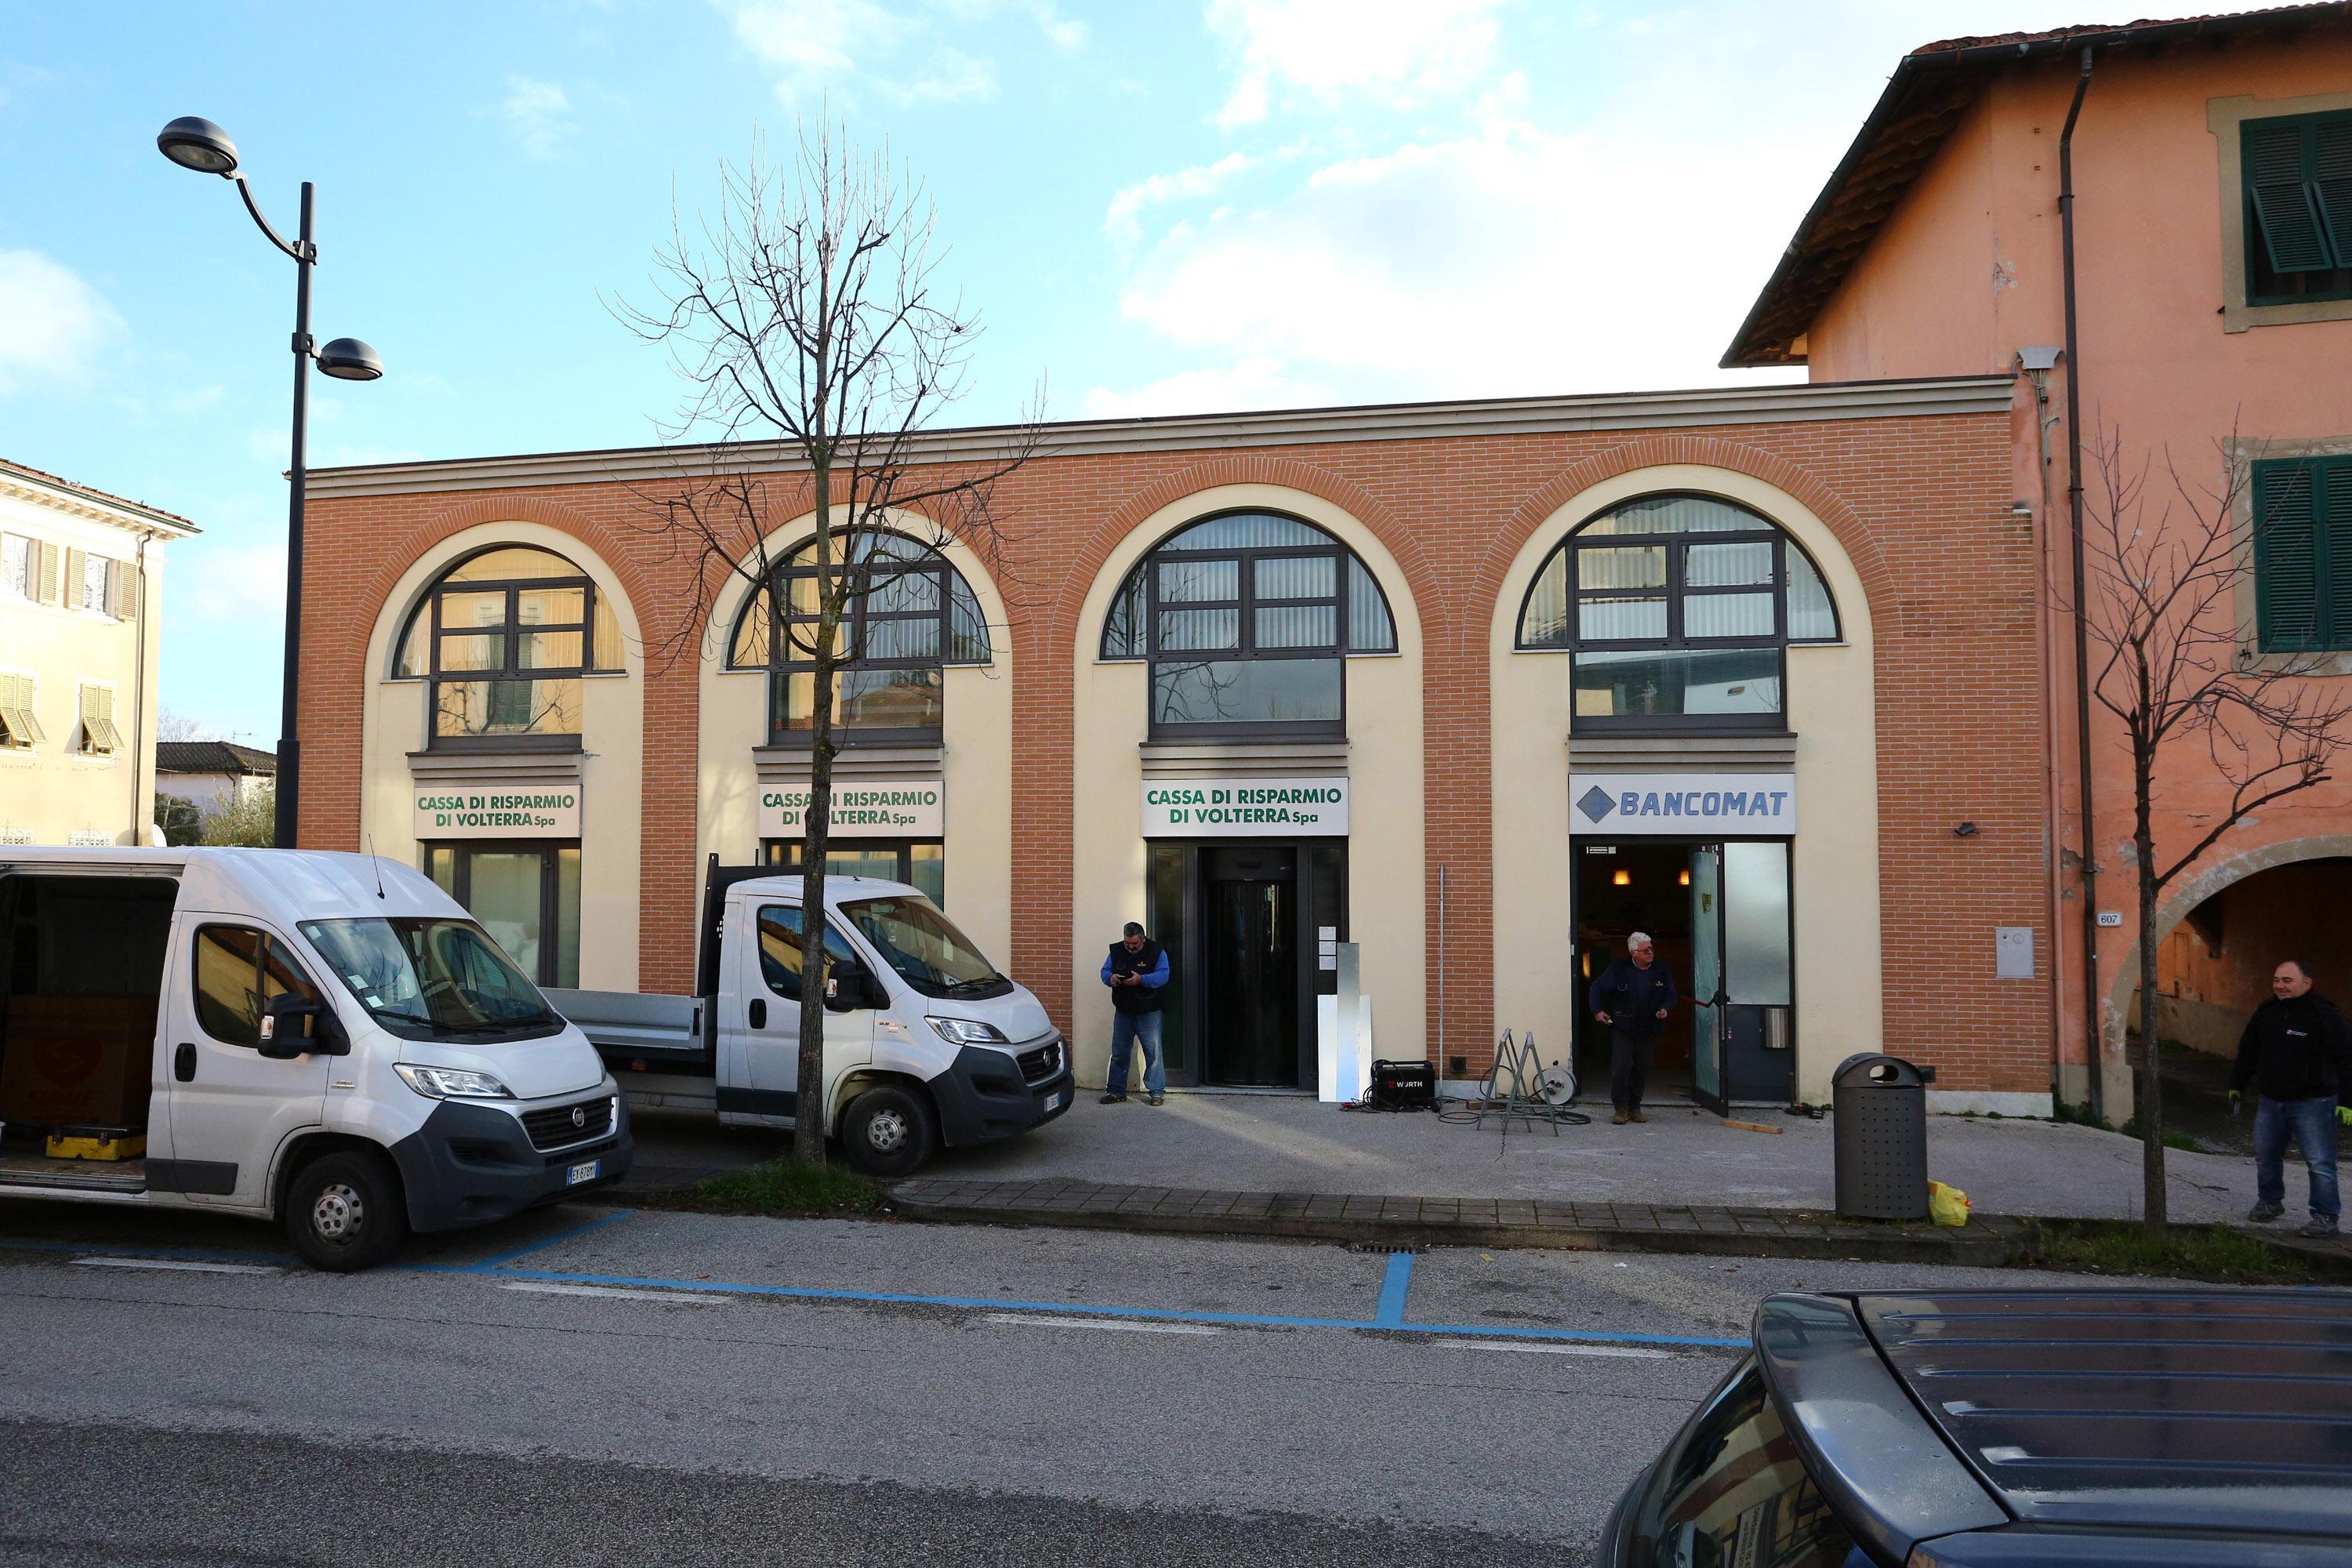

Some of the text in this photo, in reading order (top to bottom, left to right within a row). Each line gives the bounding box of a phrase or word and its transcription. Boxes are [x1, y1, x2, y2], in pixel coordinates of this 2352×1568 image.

[418, 794, 575, 810] CASSA DI RISPARMIO
[763, 793, 812, 808] CASSA
[843, 791, 937, 806] RISPARMIO
[1147, 788, 1342, 805] CASSA DI RISPARMIO
[1620, 792, 1788, 816] BANCOMAT
[436, 812, 556, 828] DI VOLTERRA Spa
[782, 810, 916, 826] DI LTERRA Spa
[1170, 808, 1319, 826] DI VOLTERRA Spa
[2100, 914, 2118, 924] 607
